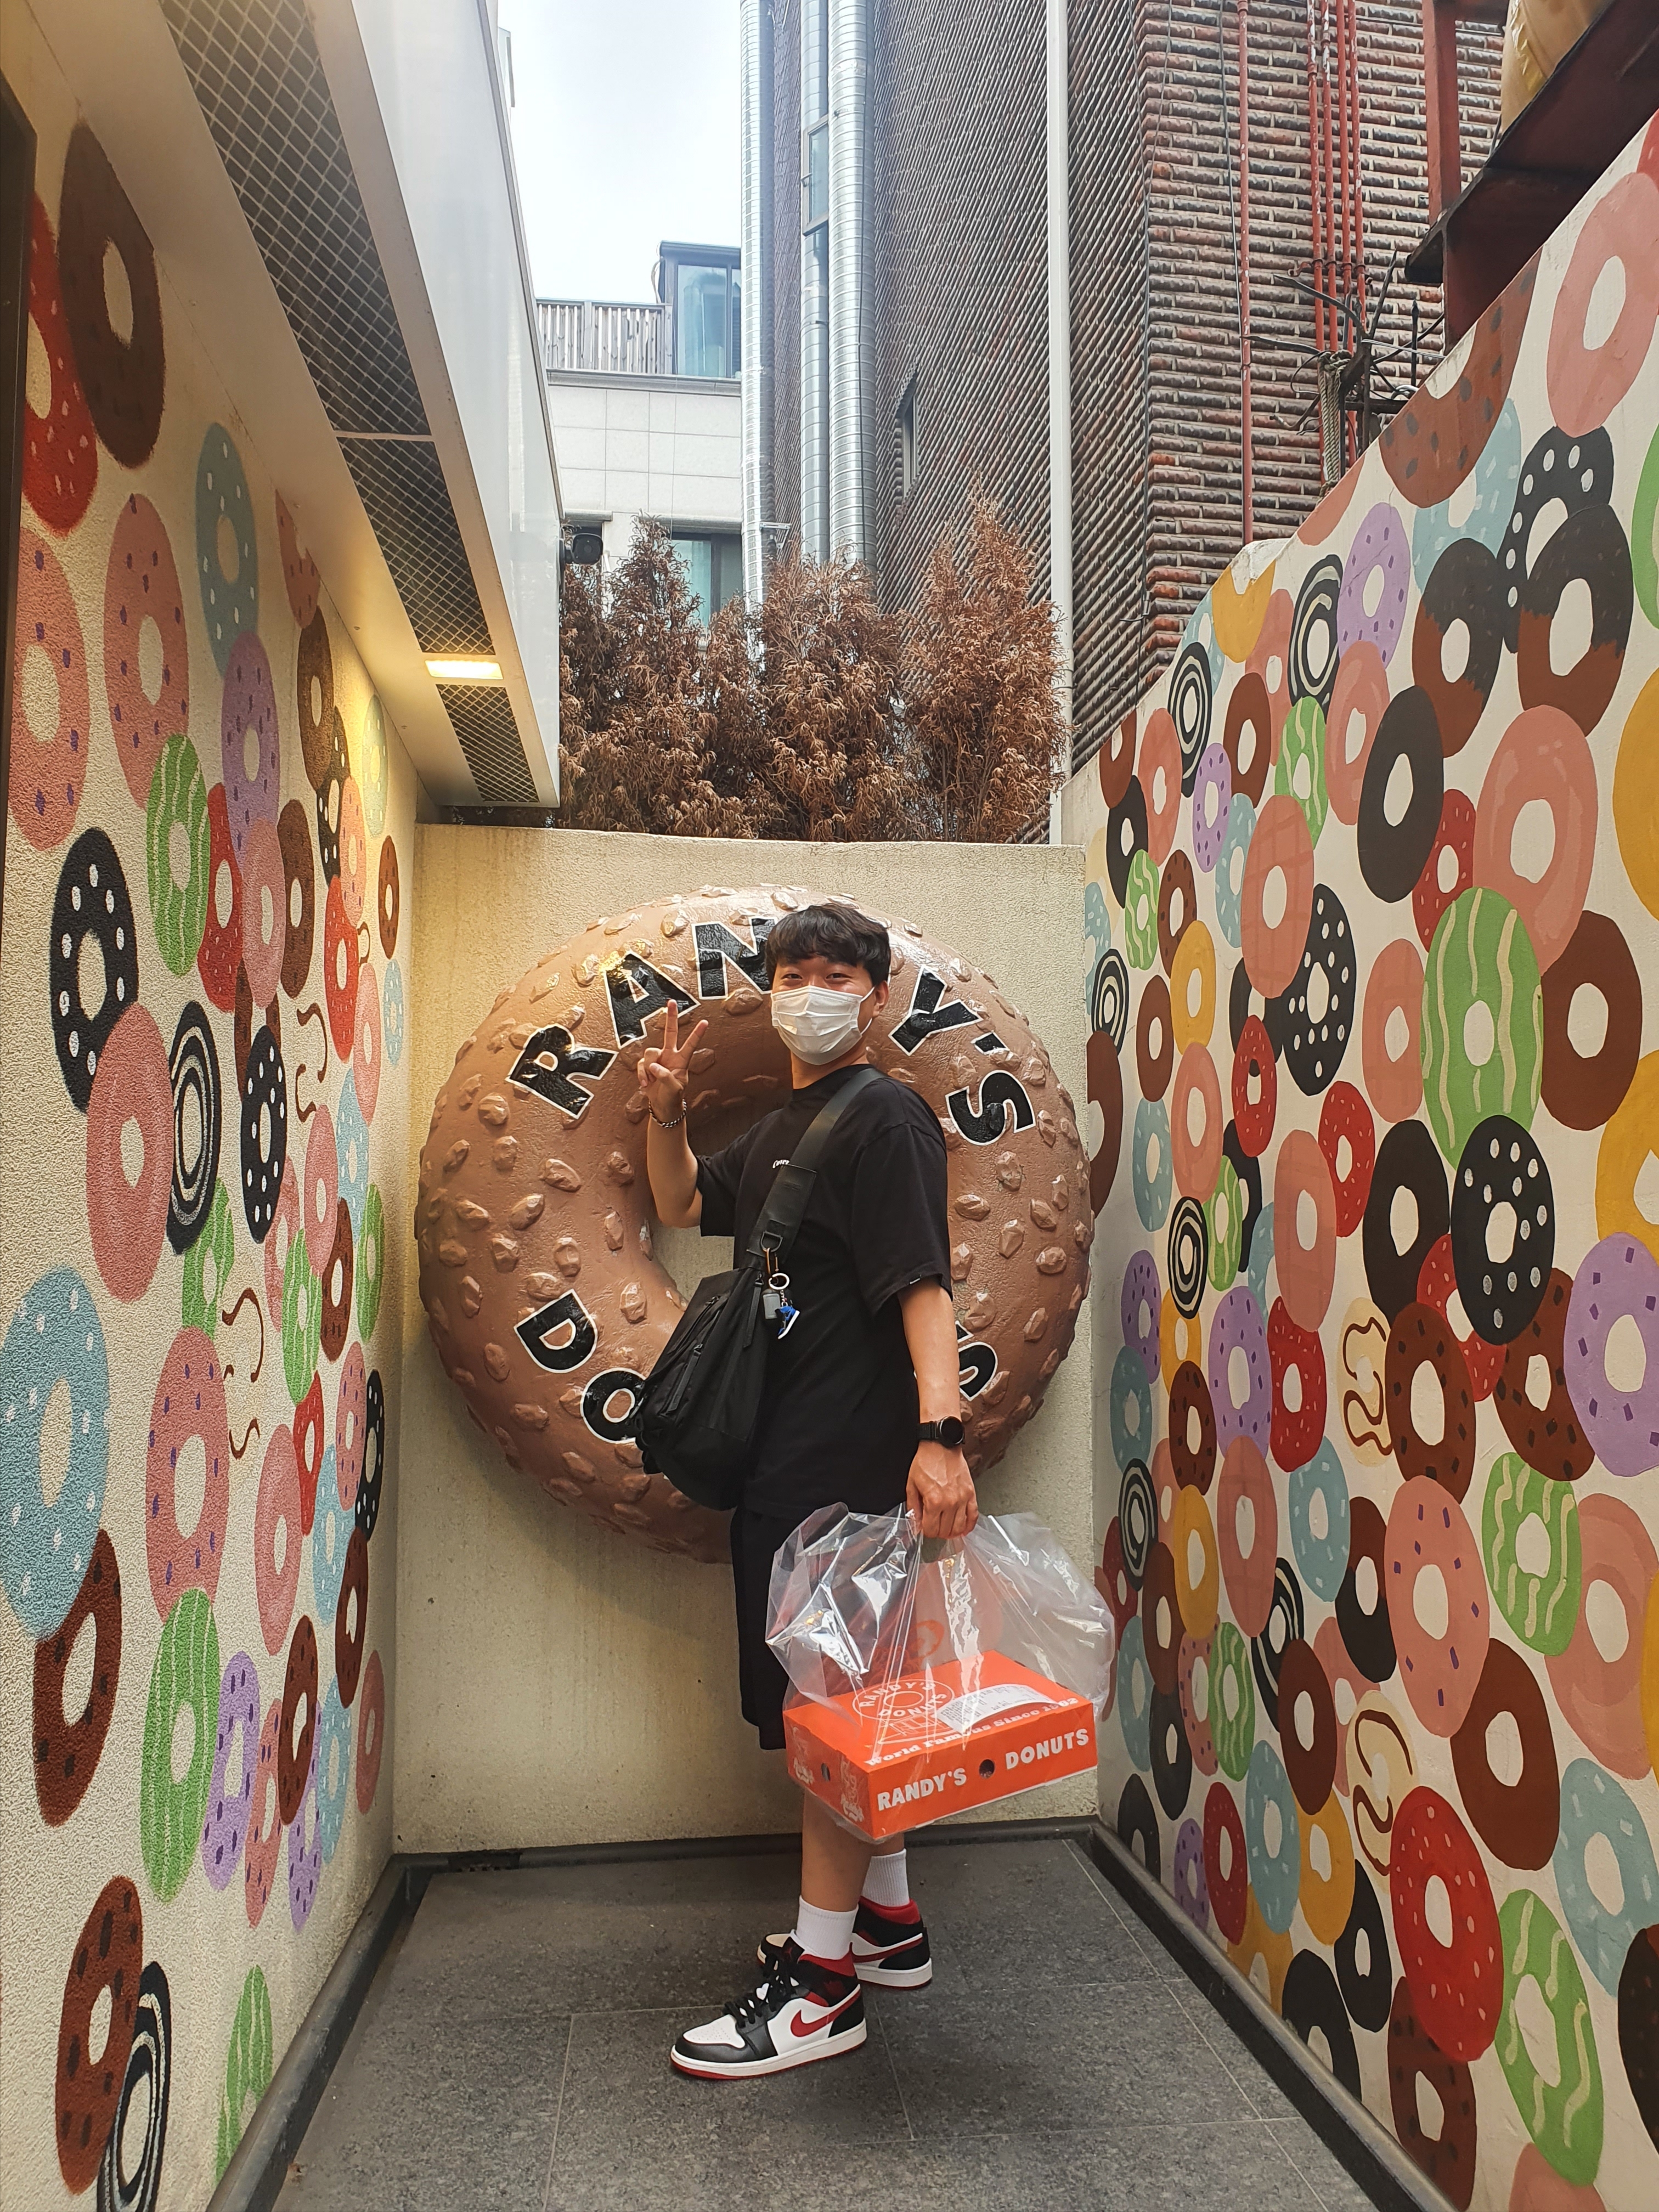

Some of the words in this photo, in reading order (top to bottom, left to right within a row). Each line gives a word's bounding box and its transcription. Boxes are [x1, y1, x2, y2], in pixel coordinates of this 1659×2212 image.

[505, 916, 1036, 1147] RANY'S
[859, 1681, 936, 1707] RANDY'S
[878, 1694, 947, 1717] DONUTS
[864, 1744, 922, 1766] World
[994, 1709, 1040, 1727] Since
[877, 1768, 967, 1812] RANDY'S
[1005, 1728, 1089, 1770] DONUTS
